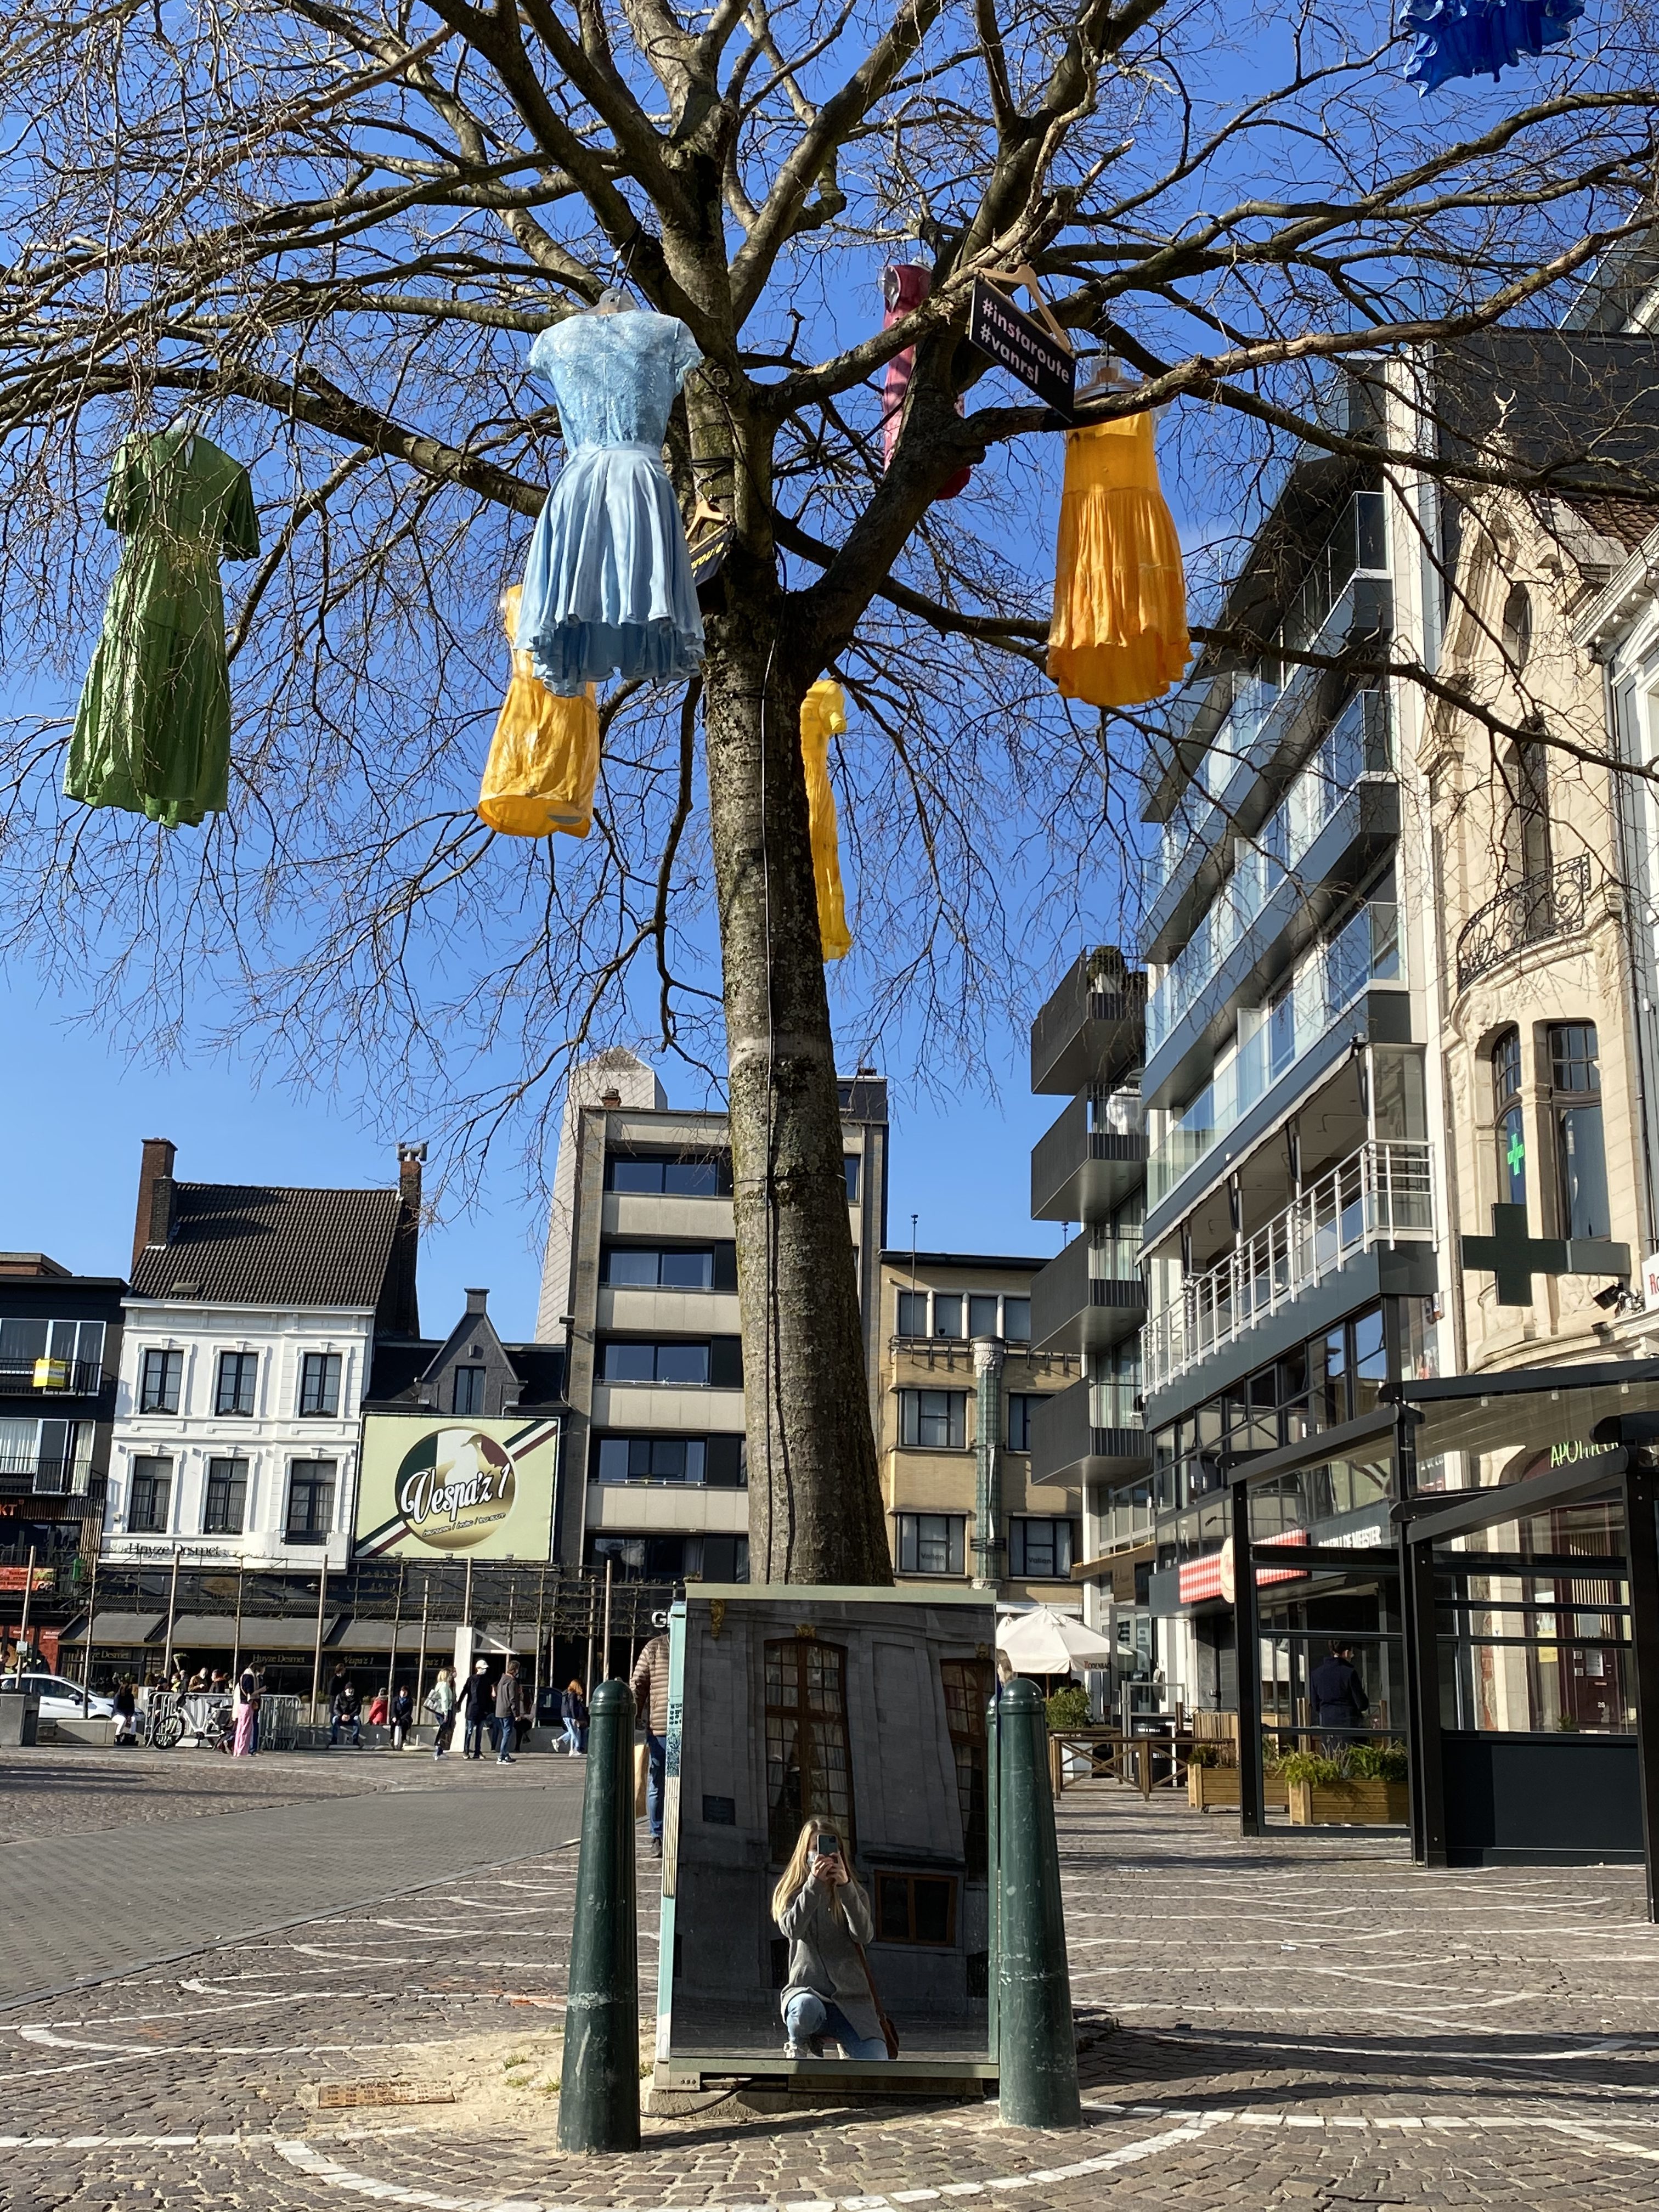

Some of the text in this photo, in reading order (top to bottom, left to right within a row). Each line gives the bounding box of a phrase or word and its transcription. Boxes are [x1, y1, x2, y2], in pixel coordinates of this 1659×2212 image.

[980, 323, 1039, 385] #vanrsl
[982, 298, 1070, 384] #instaroute
[400, 1460, 511, 1525] Vespa'z 1
